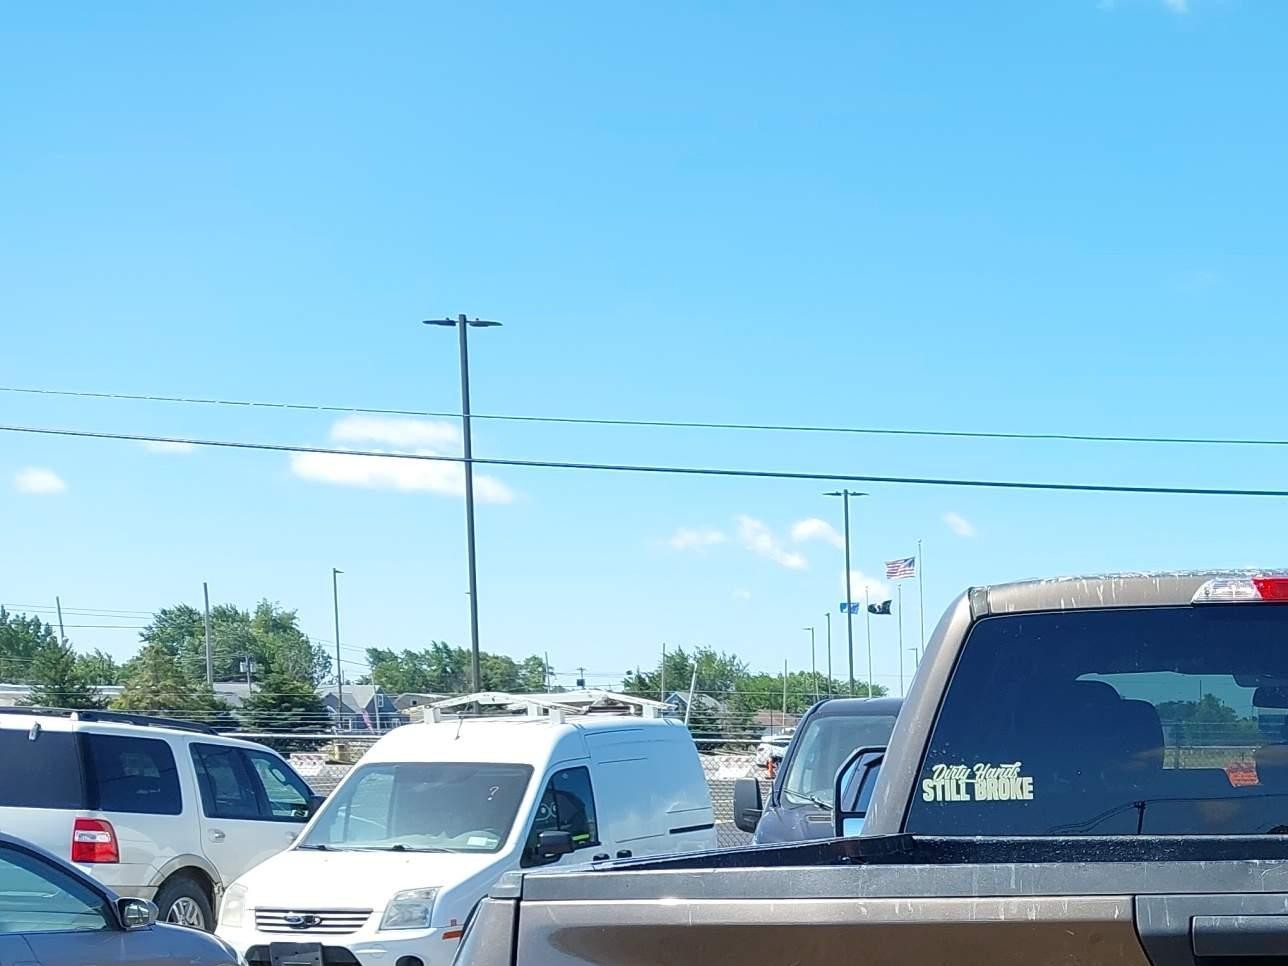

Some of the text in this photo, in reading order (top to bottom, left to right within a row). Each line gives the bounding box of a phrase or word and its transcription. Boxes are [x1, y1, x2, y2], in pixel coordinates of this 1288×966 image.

[932, 761, 1022, 782] Dirty Hands
[922, 776, 1034, 801] STILL BROKE
